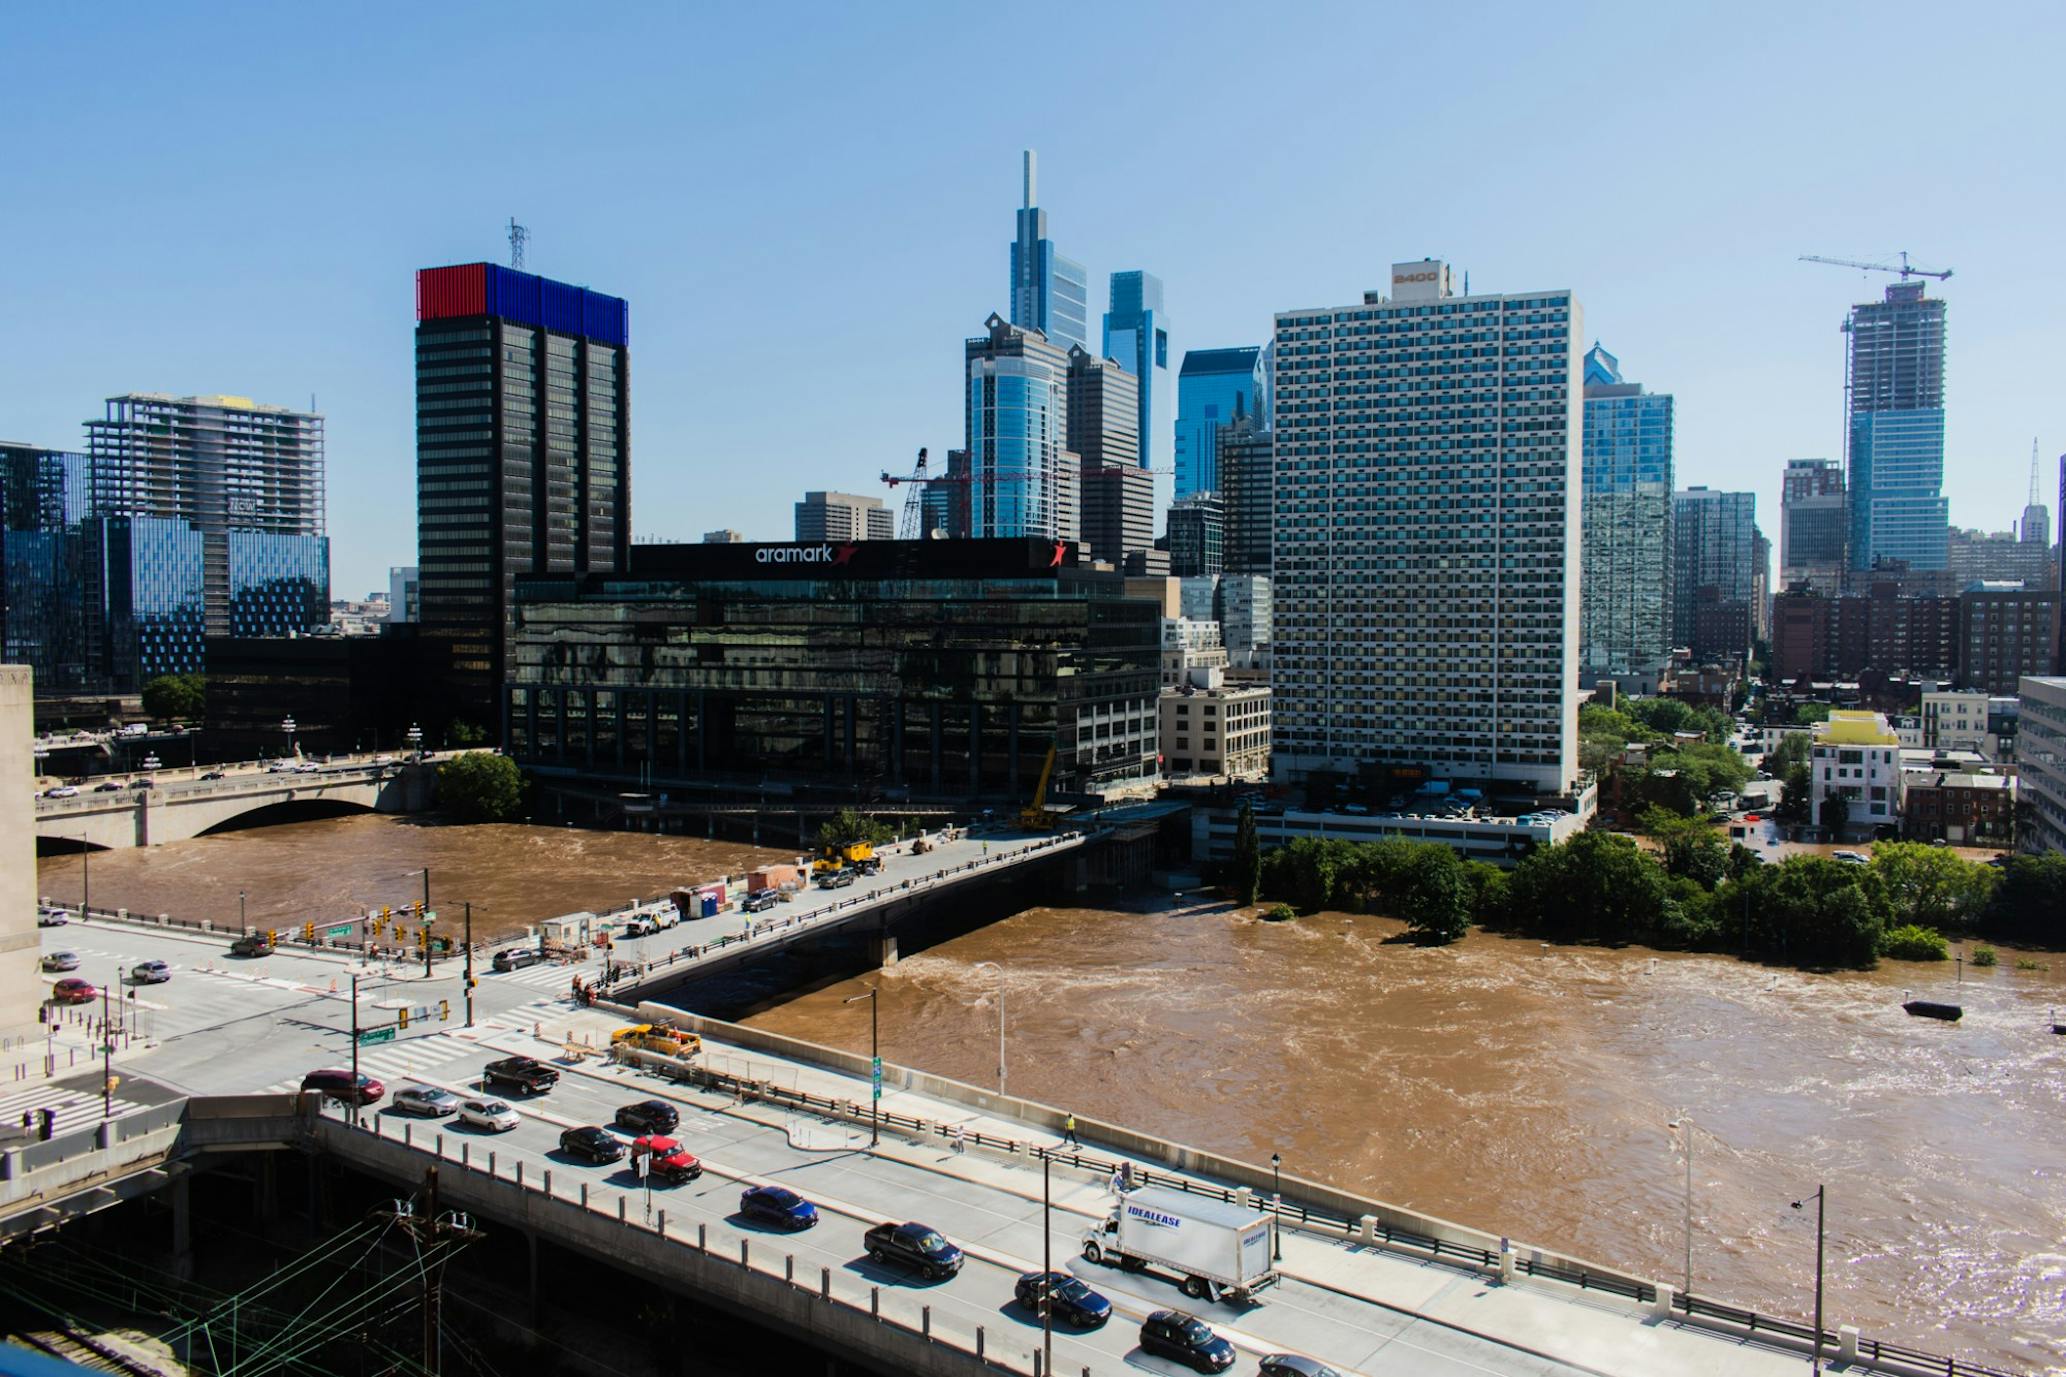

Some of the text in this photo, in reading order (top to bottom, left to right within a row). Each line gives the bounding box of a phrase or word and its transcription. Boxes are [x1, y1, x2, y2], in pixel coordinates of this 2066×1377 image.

[1393, 272, 1437, 284] 2400
[755, 543, 832, 563] aramark
[1128, 1206, 1181, 1228] IDEALEASE
